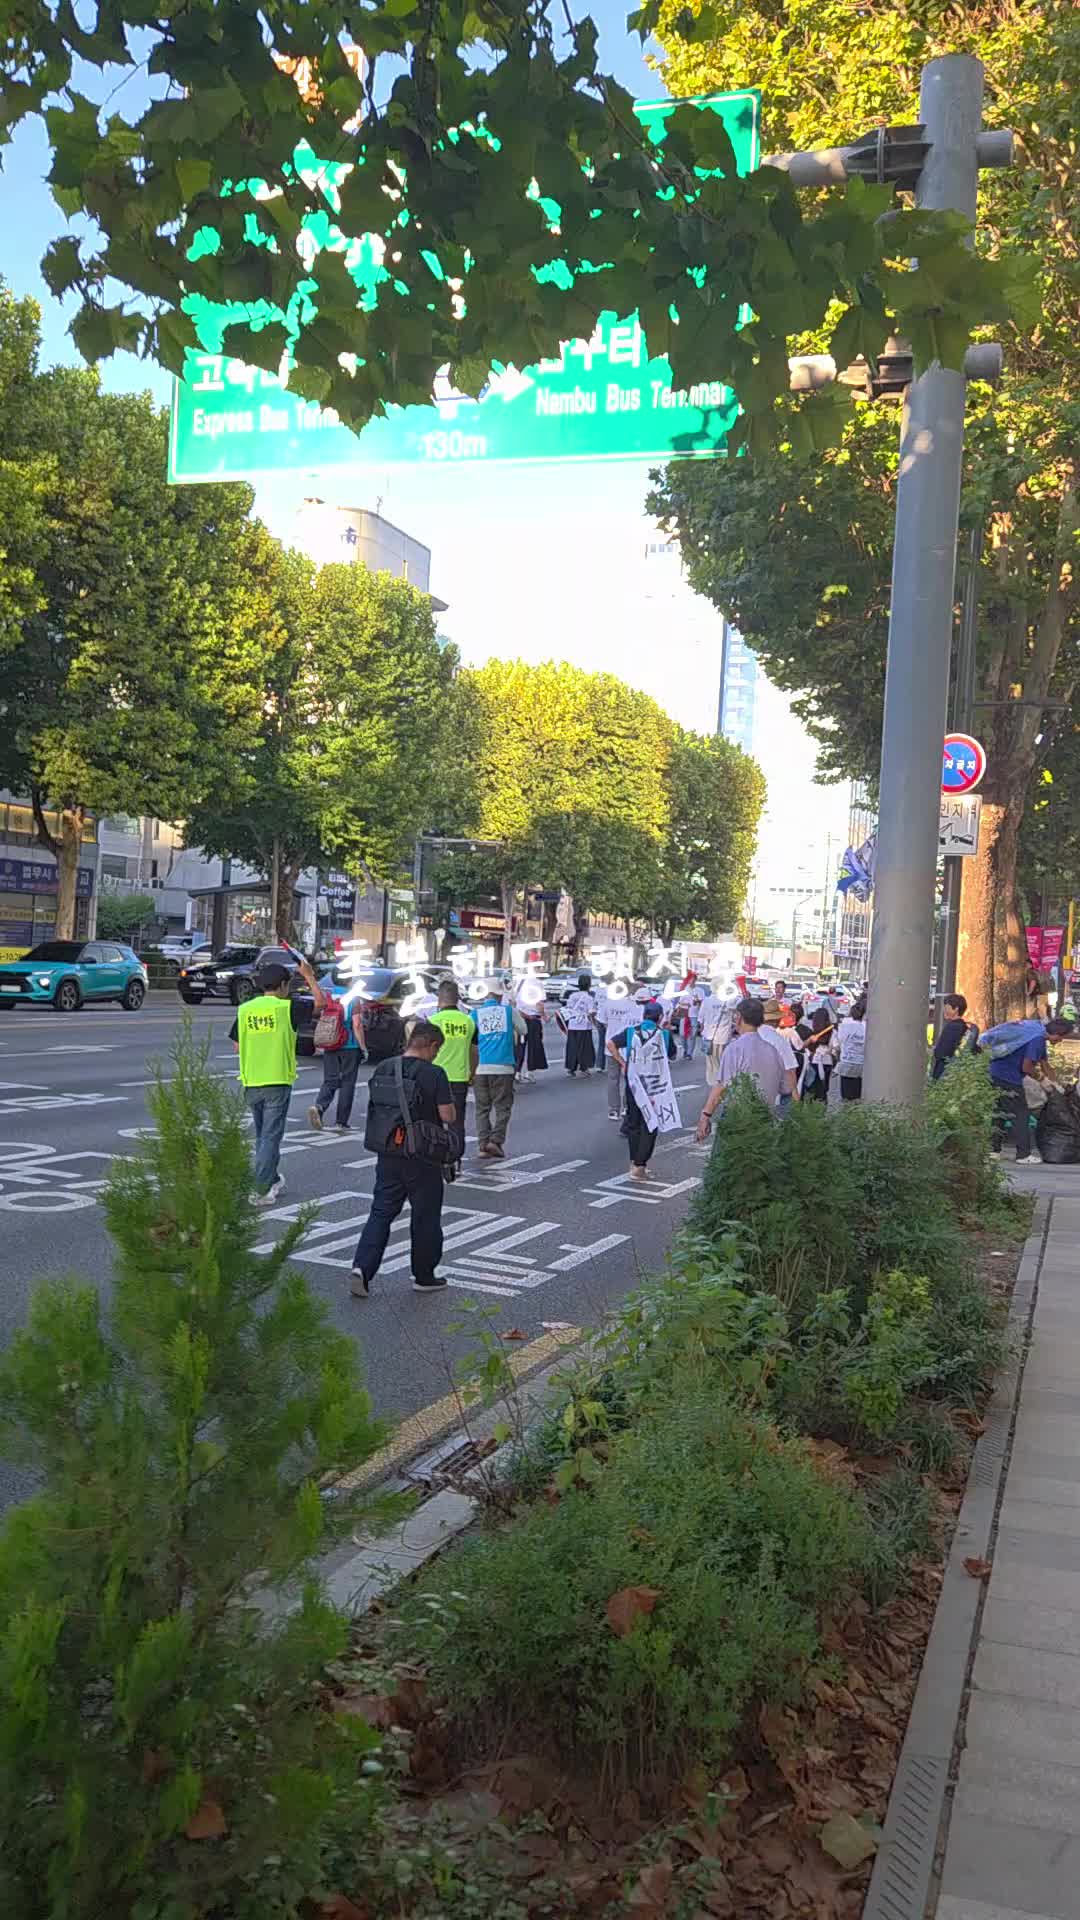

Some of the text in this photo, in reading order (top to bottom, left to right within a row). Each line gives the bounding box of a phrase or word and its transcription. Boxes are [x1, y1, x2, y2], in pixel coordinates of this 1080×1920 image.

[536, 385, 597, 416] Nambu
[605, 383, 641, 413] Bus
[421, 430, 487, 458] 130m
[945, 760, 976, 770] 차금지
[940, 802, 977, 818] 인지역
[320, 885, 350, 896] Coffee
[333, 898, 352, 909] Beer
